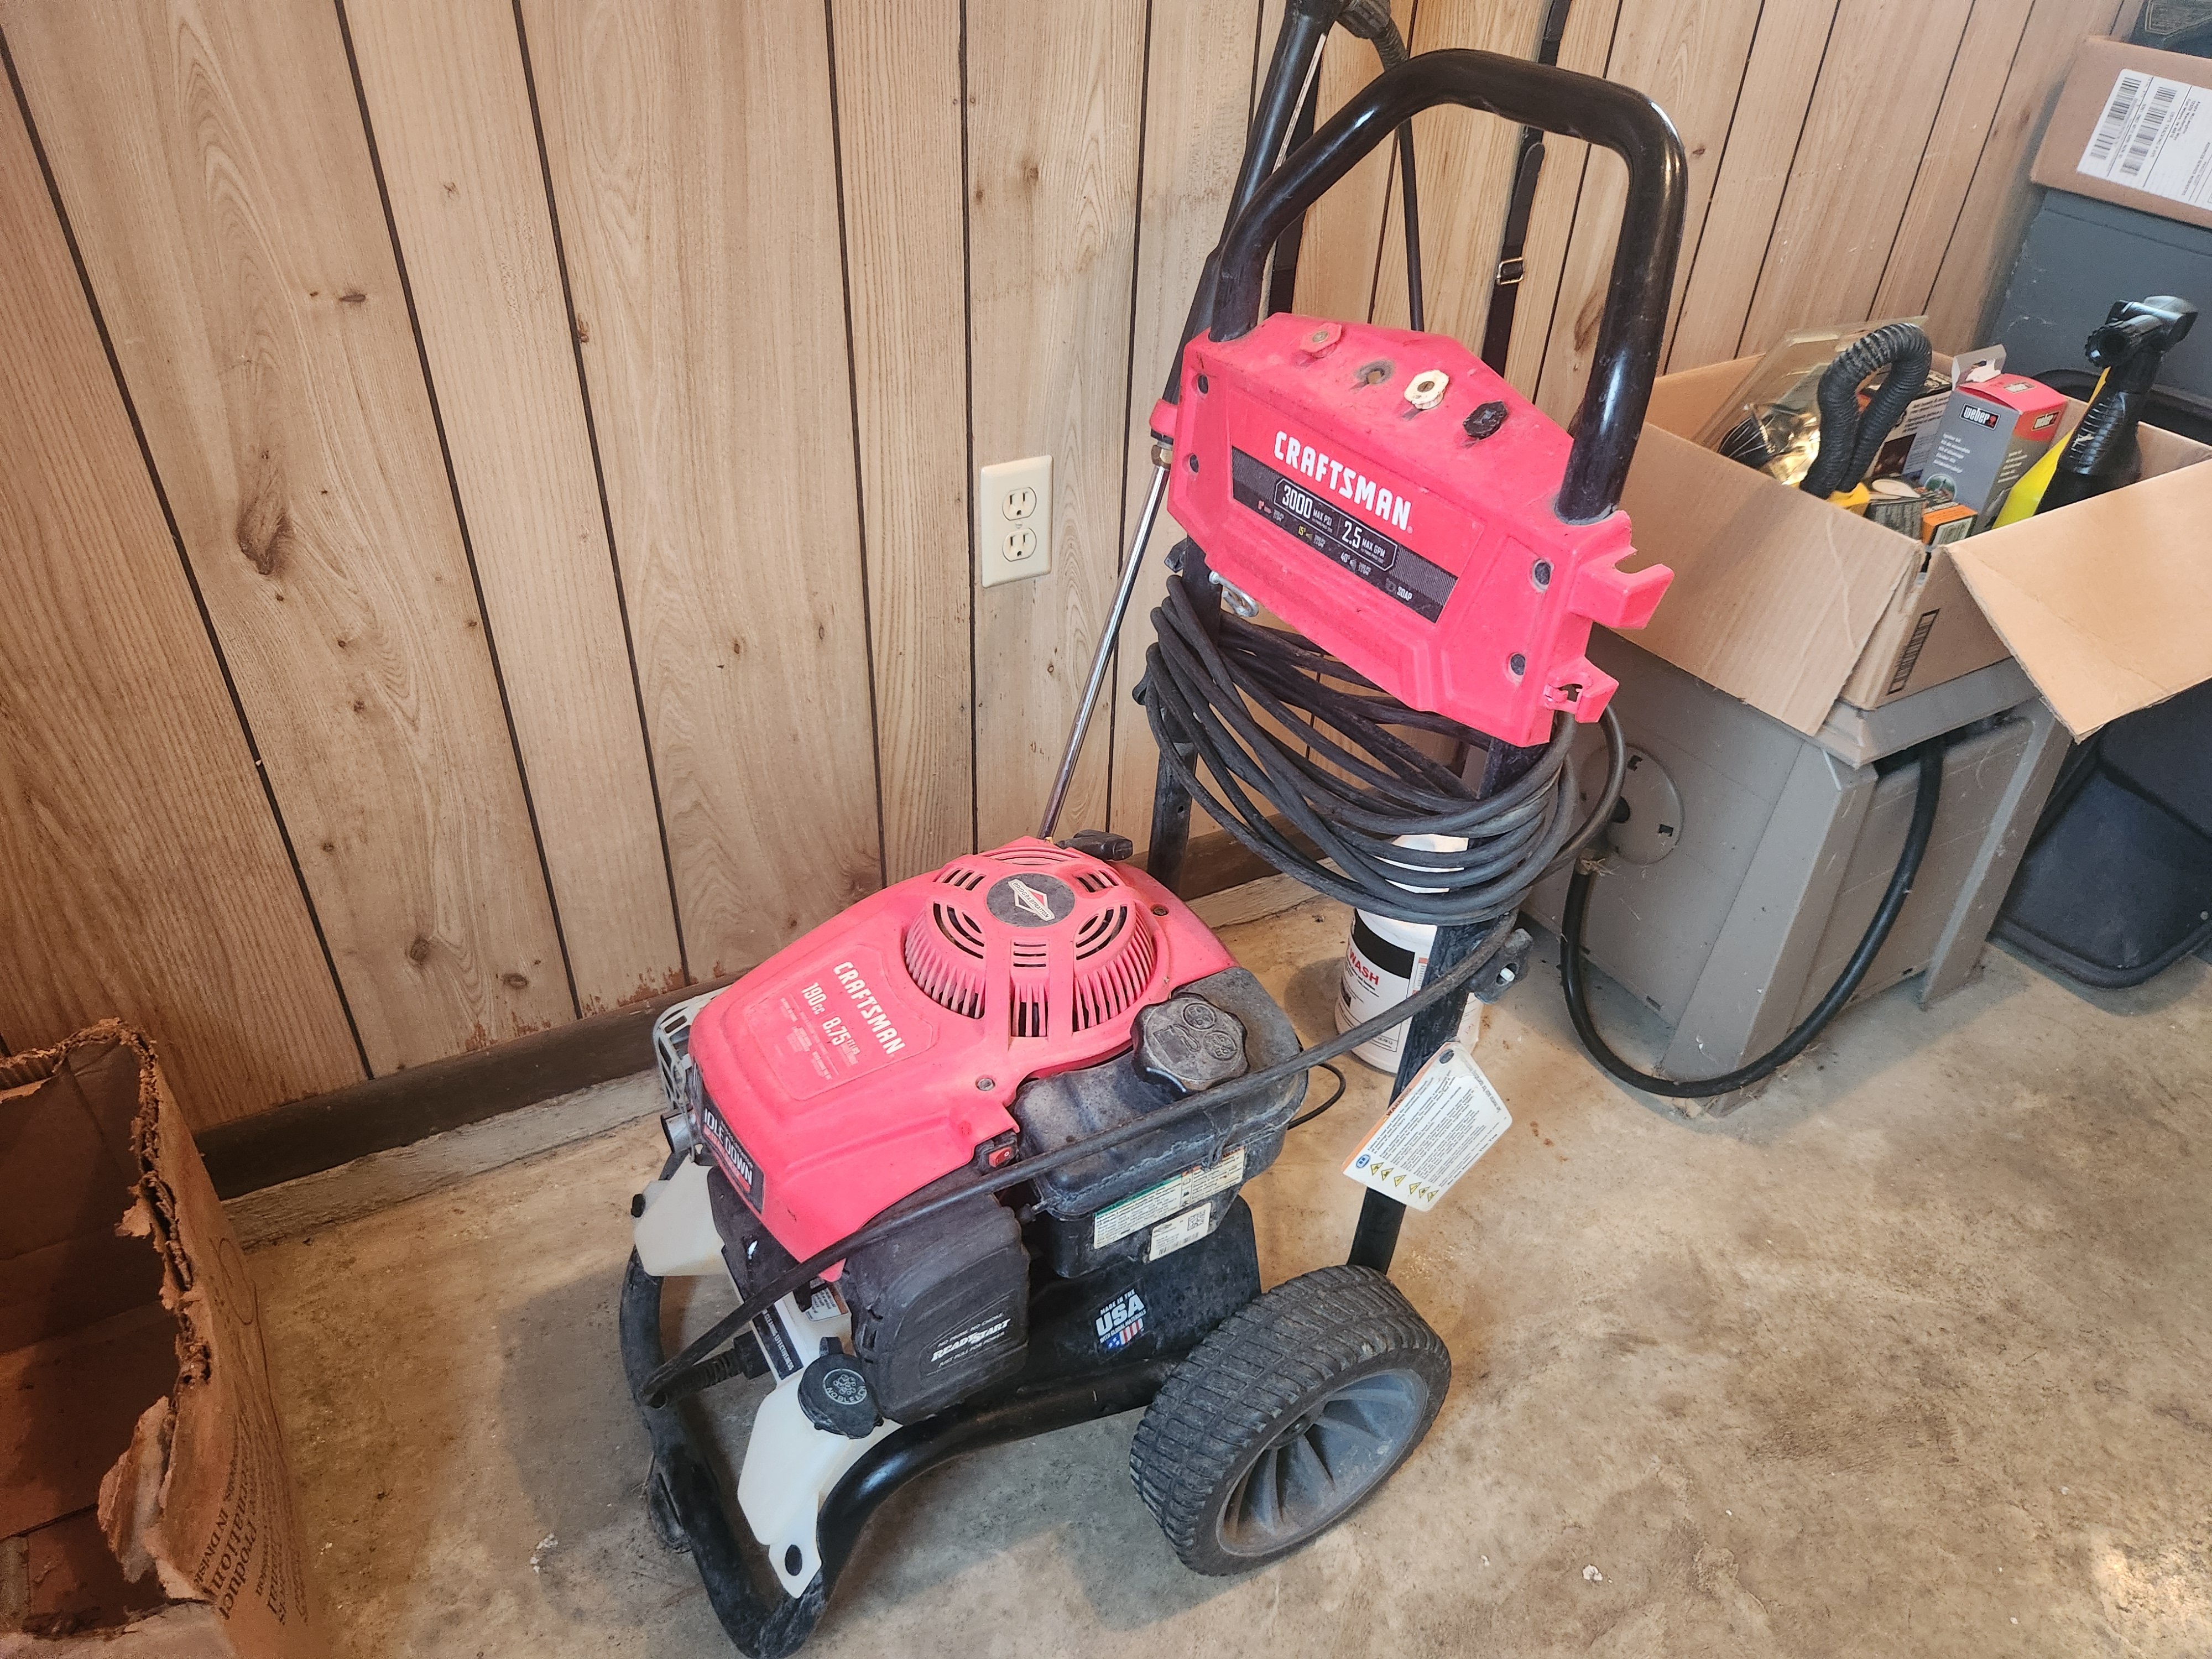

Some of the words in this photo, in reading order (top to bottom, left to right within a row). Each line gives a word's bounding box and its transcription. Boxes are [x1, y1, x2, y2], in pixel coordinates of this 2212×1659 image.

[1963, 406, 1990, 424] weber
[1274, 430, 1412, 531] CRAFTSMAN
[1282, 484, 1313, 519] 3000
[1313, 508, 1324, 521] MAX
[1323, 514, 1333, 526] PSI
[1342, 520, 1363, 549] 2.5
[1362, 538, 1373, 551] MAX
[1373, 543, 1386, 559] GPM
[1397, 586, 1412, 601] SOAP
[1350, 948, 1379, 985] WASH
[833, 962, 905, 1055] CRAFTSMAN
[822, 1016, 852, 1046] 8.75
[705, 1108, 723, 1144] IDLE
[725, 1136, 753, 1186] DOWN
[1095, 1294, 1145, 1336] USA
[1100, 1301, 1117, 1315] MADE
[1117, 1296, 1124, 1305] IN
[1124, 1288, 1135, 1300] THE
[969, 1342, 983, 1352] FOR
